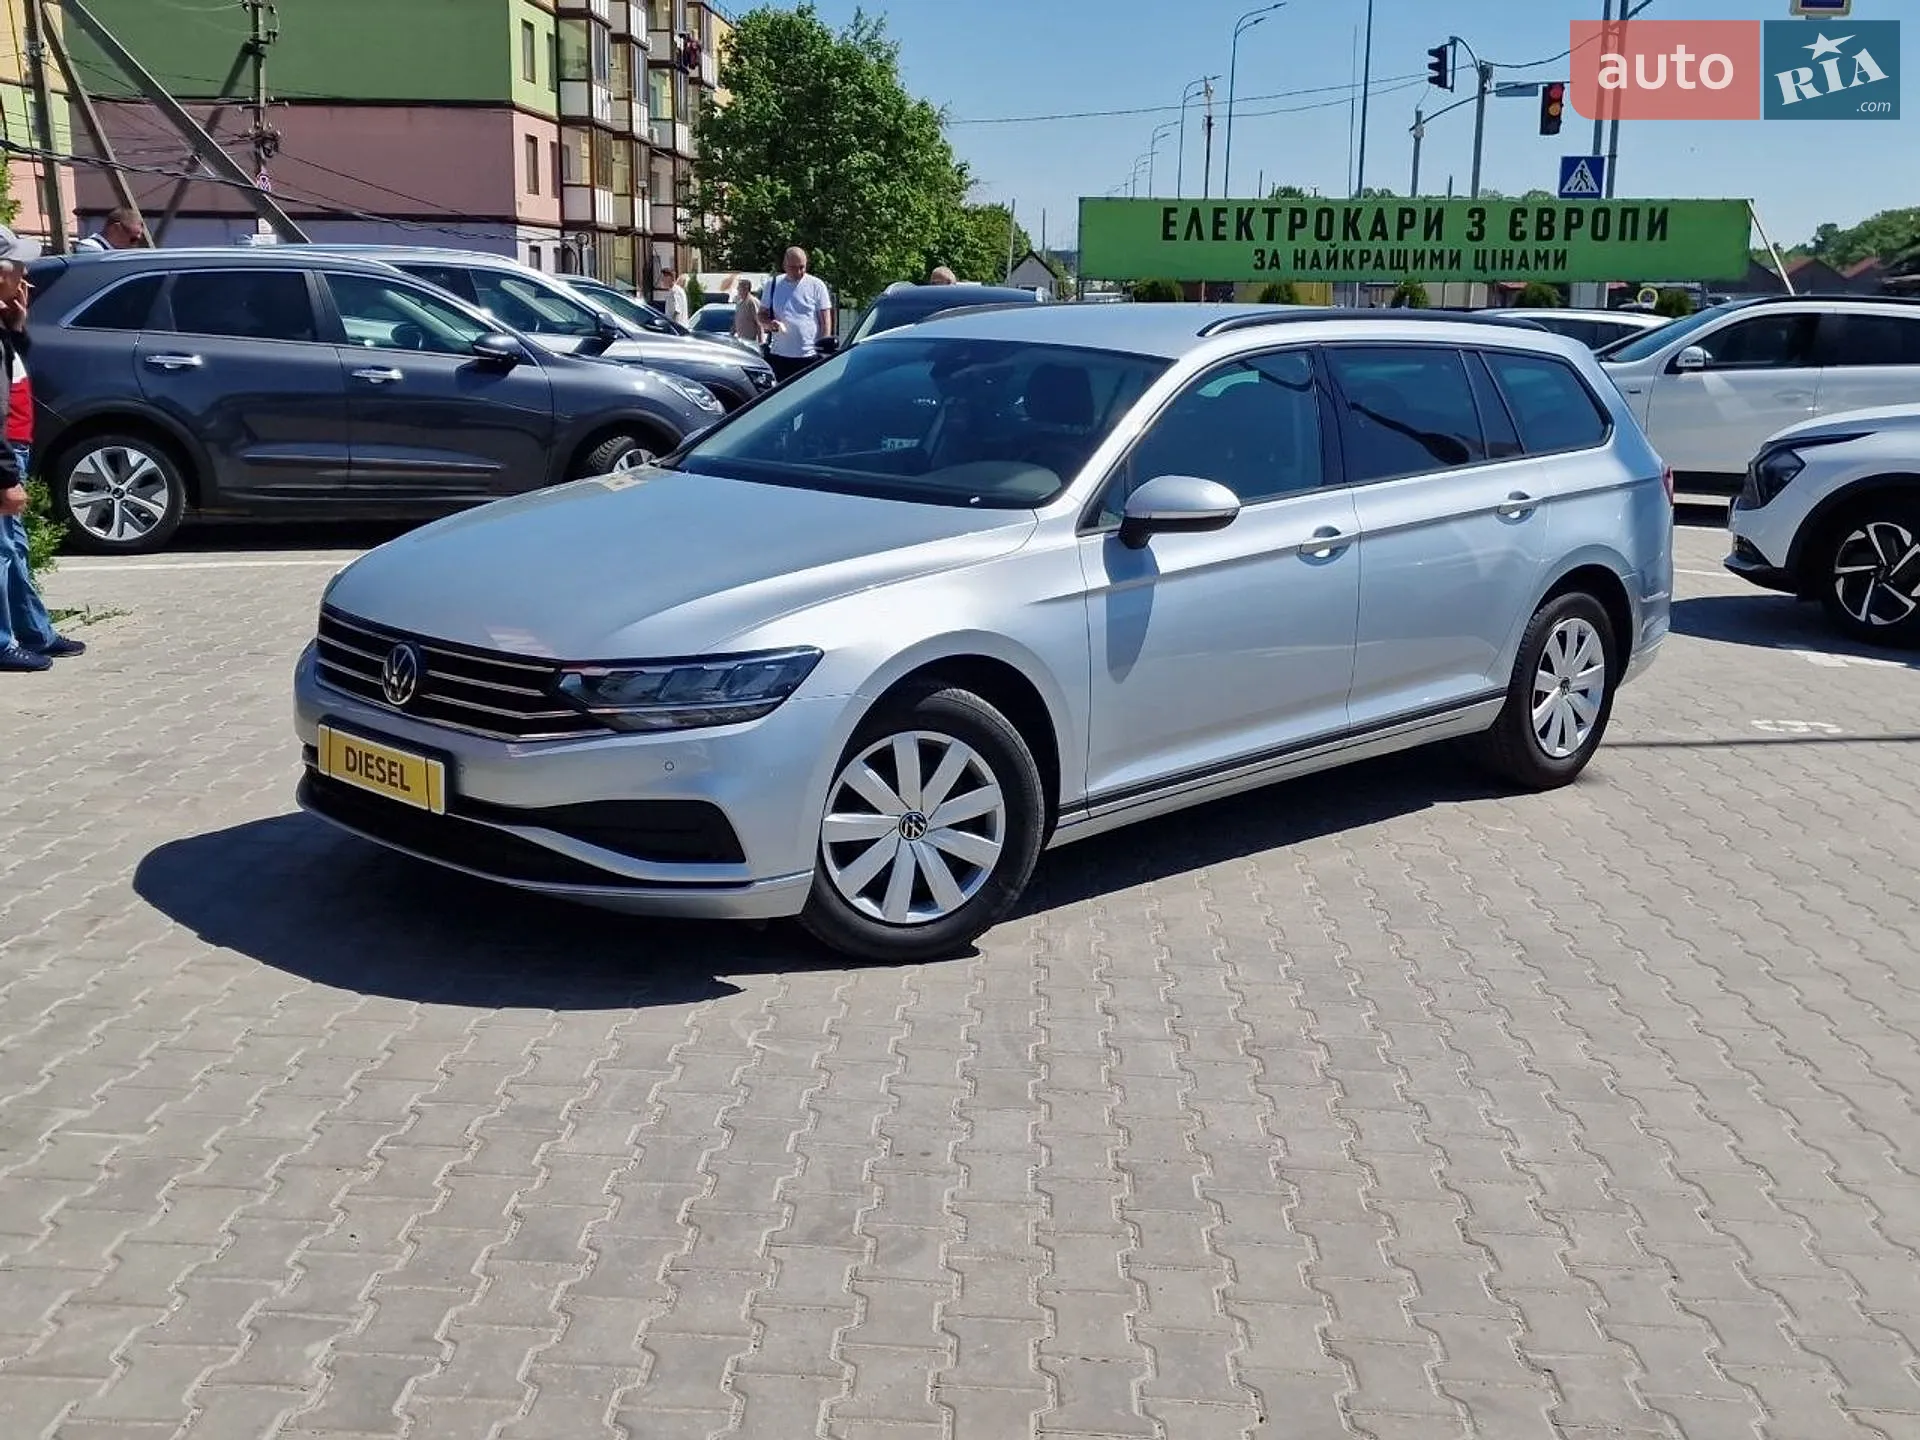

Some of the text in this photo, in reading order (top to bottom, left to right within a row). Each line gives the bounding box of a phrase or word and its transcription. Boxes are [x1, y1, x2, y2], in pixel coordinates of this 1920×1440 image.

[1161, 206, 1445, 242] ЕЛЕКТРОКАРИ
[1508, 206, 1670, 242] ЄВРОПИ
[1253, 243, 1568, 273] ЗА НАЙКРАЩИМИ ЦІНАМИ
[344, 746, 411, 792] DIESEL
